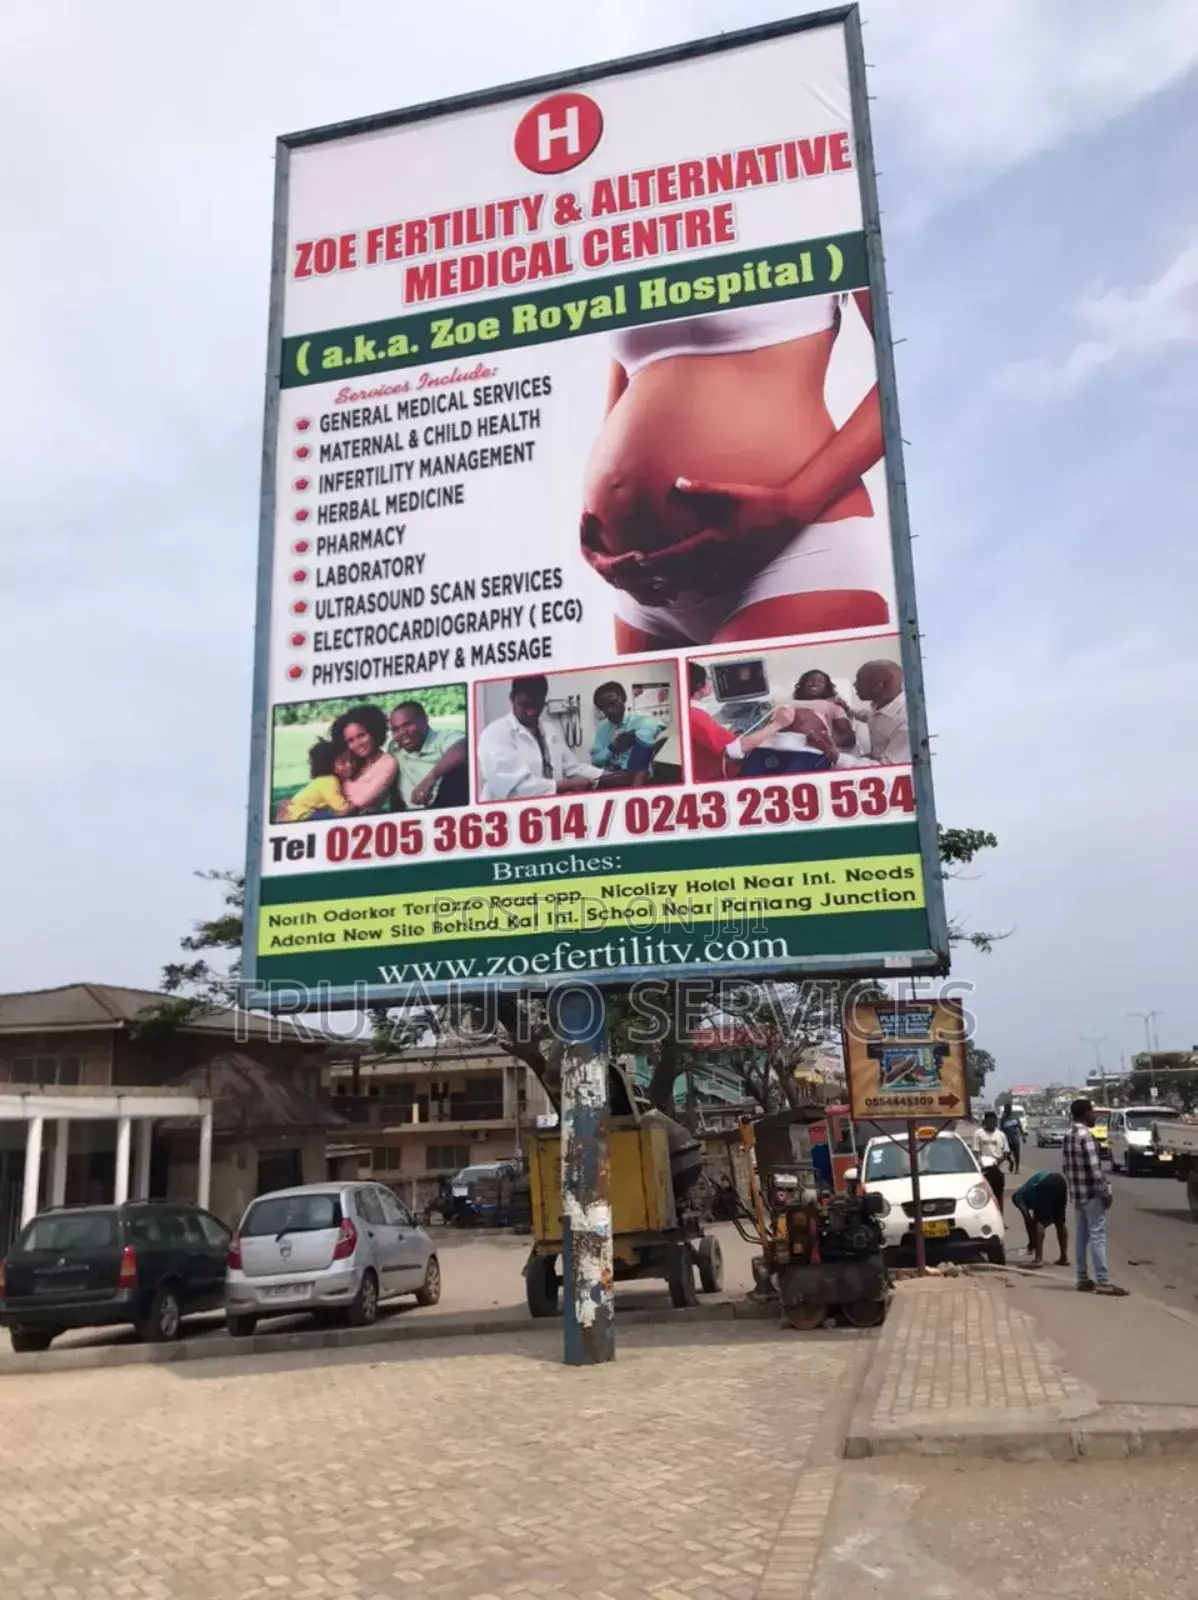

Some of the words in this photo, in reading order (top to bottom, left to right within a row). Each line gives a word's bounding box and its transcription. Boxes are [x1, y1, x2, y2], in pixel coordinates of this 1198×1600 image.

[537, 107, 580, 161] H
[294, 234, 356, 279] ZOE
[367, 193, 544, 262] FERTILITY
[554, 192, 582, 227] &
[592, 131, 853, 216] ALTERNATIVE
[404, 240, 574, 304] MEDICAL
[582, 203, 735, 268] CENTRE
[322, 337, 418, 369] a.k.a.
[431, 316, 500, 350] Zoe
[512, 293, 627, 344] Royal
[641, 252, 814, 309] Hospital
[320, 404, 392, 433] GENERAL
[397, 391, 469, 419] MEDICAL
[474, 376, 551, 407] SERVICES
[334, 379, 411, 404] Services
[417, 362, 498, 391] Include:
[319, 433, 404, 463] MATERNAL
[409, 428, 419, 449] &
[424, 420, 472, 446] CHILD
[477, 409, 541, 437] HEALTH
[319, 461, 414, 494] INFERTILITY
[419, 441, 535, 474] MANAGEMENT
[318, 499, 380, 525] HERBAL
[385, 484, 465, 514] MEDICINE
[317, 525, 406, 556] PHARMACY
[315, 590, 425, 620] ULTRASOUND
[430, 579, 475, 605] SCAN
[481, 568, 563, 598] SERVICES
[316, 554, 426, 587] LABORATORY
[314, 605, 523, 652] ELECTROCARDIOGRAPHY
[312, 649, 449, 685] PHYSIOTHERAPY
[454, 645, 465, 668] &
[471, 636, 552, 666] MASSAGE
[270, 834, 316, 862] Tel
[327, 819, 423, 861] 0205
[434, 811, 508, 851] 363
[519, 803, 587, 845] 614
[596, 799, 613, 838] /
[625, 790, 727, 834] 0243
[737, 783, 818, 826] 239
[830, 774, 916, 818] 534
[493, 853, 622, 881] Branches:
[269, 911, 317, 928] North
[491, 893, 538, 909] Road
[687, 876, 736, 893] Hotel
[744, 873, 794, 890] Near
[803, 870, 835, 886] Int.
[846, 864, 914, 882] Needs
[343, 927, 383, 942] New
[391, 923, 425, 938] Site
[432, 916, 499, 935] Behind
[548, 910, 579, 926] Int.
[587, 904, 653, 922] School
[663, 899, 712, 917] Near
[820, 887, 916, 908] Junction
